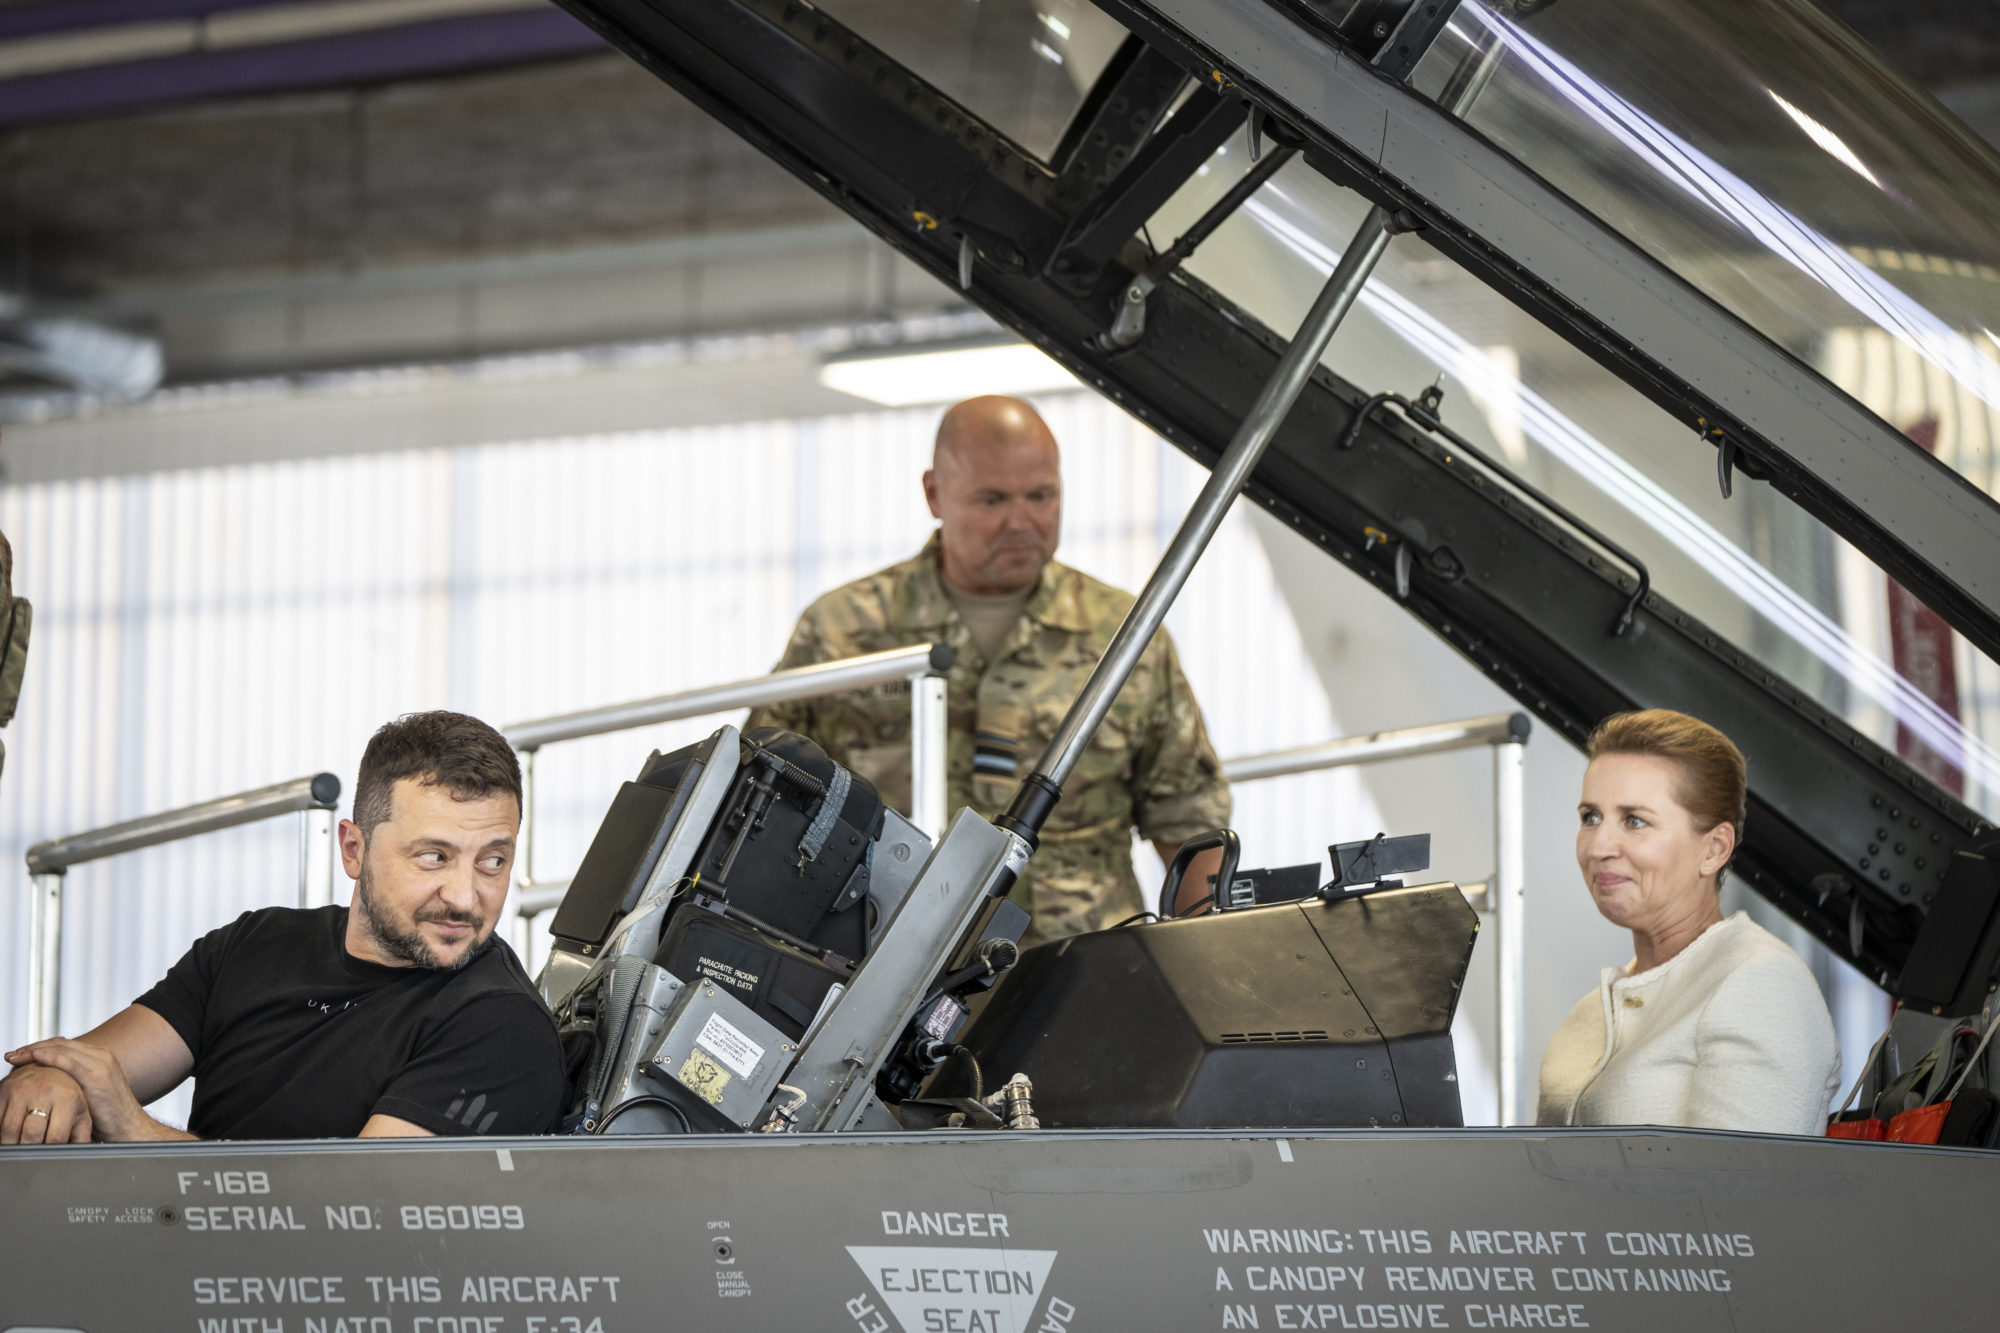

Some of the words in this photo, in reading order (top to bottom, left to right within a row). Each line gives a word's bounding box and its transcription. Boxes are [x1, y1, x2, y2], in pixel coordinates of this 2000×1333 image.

[699, 956, 733, 974] PARACHUTE
[734, 969, 758, 983] PACKING
[703, 967, 736, 985] INSPECTION
[737, 980, 753, 991] DATA
[178, 1171, 270, 1194] F-16B
[67, 1207, 109, 1215] CANOPY
[125, 1207, 154, 1215] LOCK
[68, 1214, 106, 1223] SAFETY
[114, 1214, 153, 1223] ACCESS
[185, 1206, 305, 1231] SERIAL
[400, 1205, 525, 1230] 860199
[706, 1221, 731, 1230] OPEN
[881, 1211, 1010, 1237] DANGER
[1203, 1229, 1354, 1254] WARNING:
[1359, 1230, 1432, 1253] THIS
[1450, 1230, 1587, 1255] AIRCRAFT
[1606, 1232, 1755, 1257] CONTAINS
[715, 1271, 744, 1280] CLOSE
[717, 1279, 750, 1289] MANUAL
[880, 1267, 1034, 1295] EJECTION
[1216, 1267, 1233, 1291] A
[1246, 1267, 1365, 1291] CANOPY
[1385, 1267, 1536, 1291] REMOVER
[1552, 1268, 1732, 1292] CONTAINING
[194, 1277, 345, 1304] SERVICE
[365, 1277, 441, 1303] THIS
[461, 1277, 621, 1302] AIRCRAFT
[719, 1288, 752, 1298] CANOPY
[198, 1318, 284, 1333] WITH
[305, 1317, 392, 1333] NATO
[414, 1317, 504, 1333] CODE
[923, 1308, 1001, 1333] SEAT
[1223, 1304, 1259, 1329] AN
[1275, 1304, 1449, 1329] EXPLOSIVE
[1465, 1304, 1589, 1329] CHARGE
